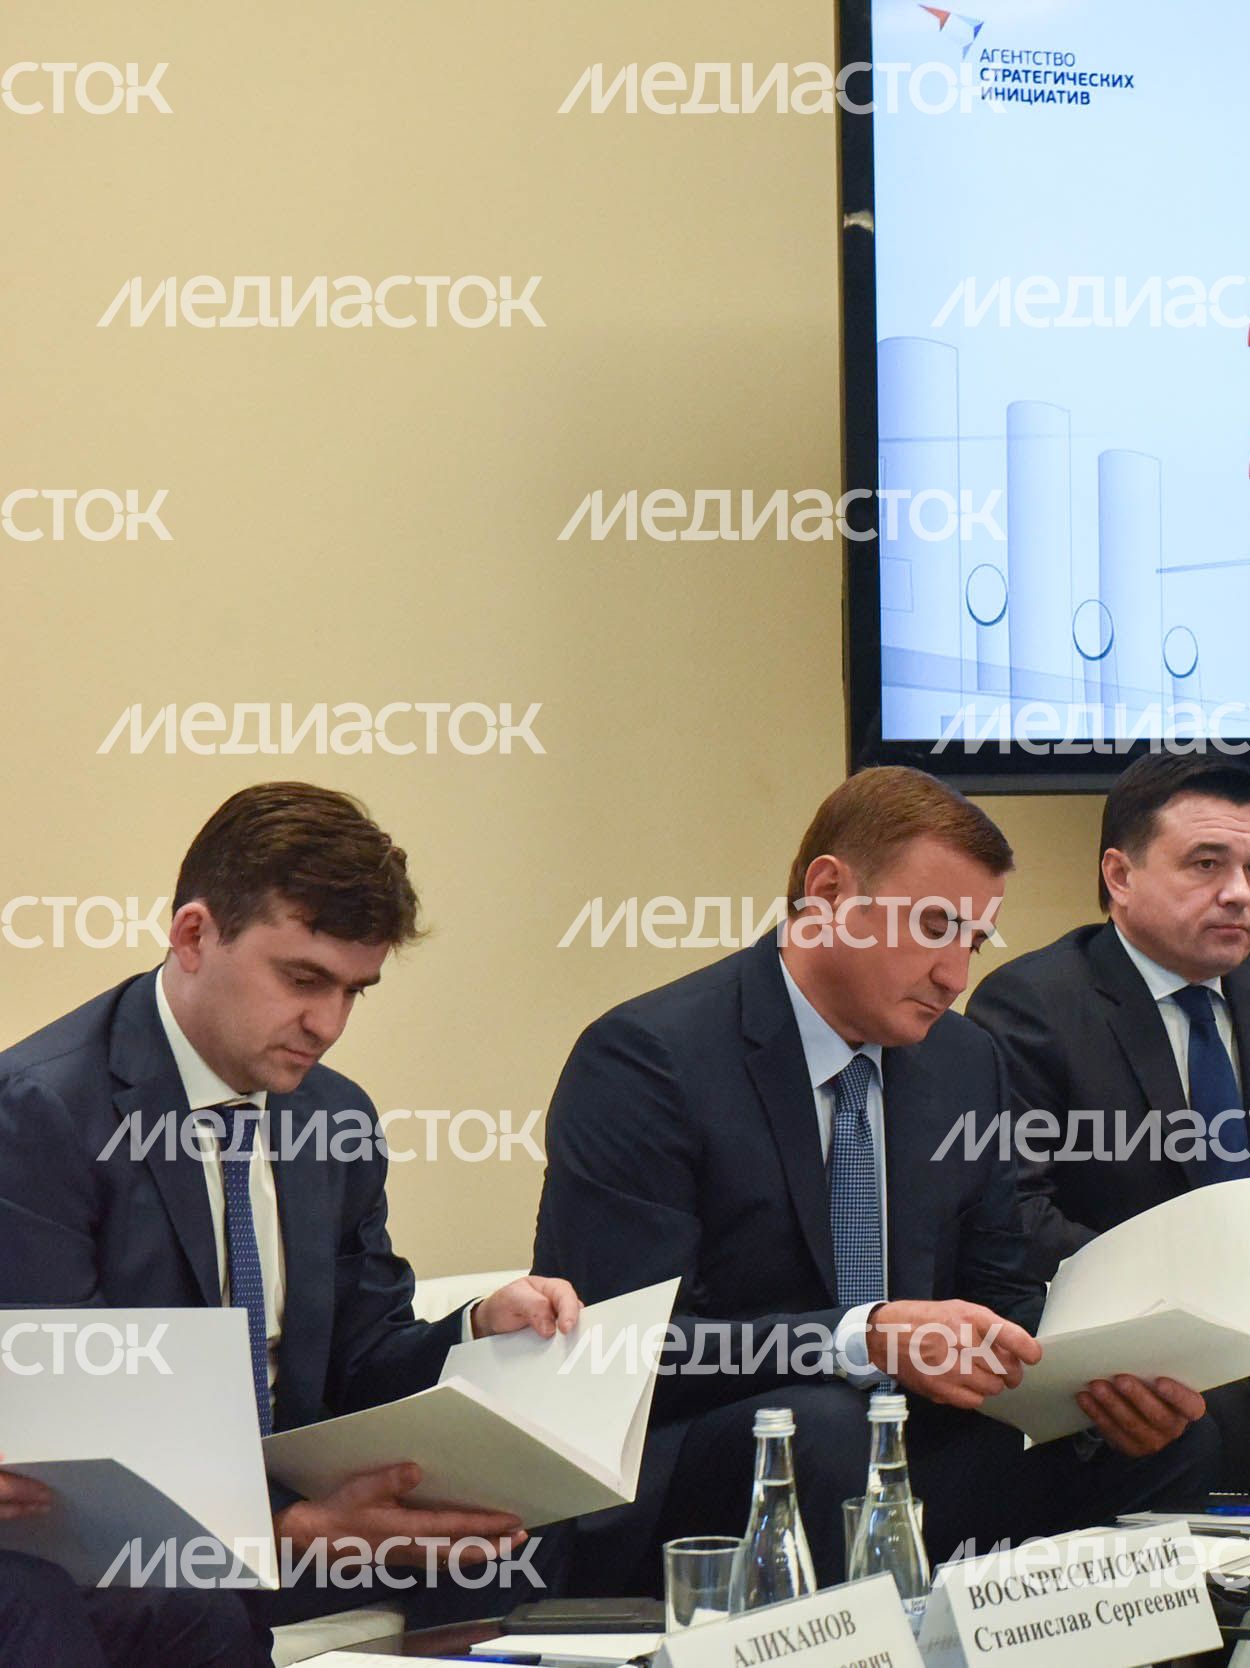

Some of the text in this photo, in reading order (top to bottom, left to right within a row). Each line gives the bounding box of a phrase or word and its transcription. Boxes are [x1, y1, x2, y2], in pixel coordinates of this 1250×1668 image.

[979, 67, 1135, 89] СТРАТЕГИЧЕСКИХ
[980, 48, 1076, 68] АГЕНТСТВО
[981, 86, 1091, 106] ИНИЦИАТИВ
[967, 1536, 1182, 1611] ВОСКРЕСЕНСКИЙ
[731, 1608, 857, 1668] АЛИХАНОВ
[973, 1610, 1093, 1653] Станислав
[1095, 1586, 1201, 1627] Сергеевич
